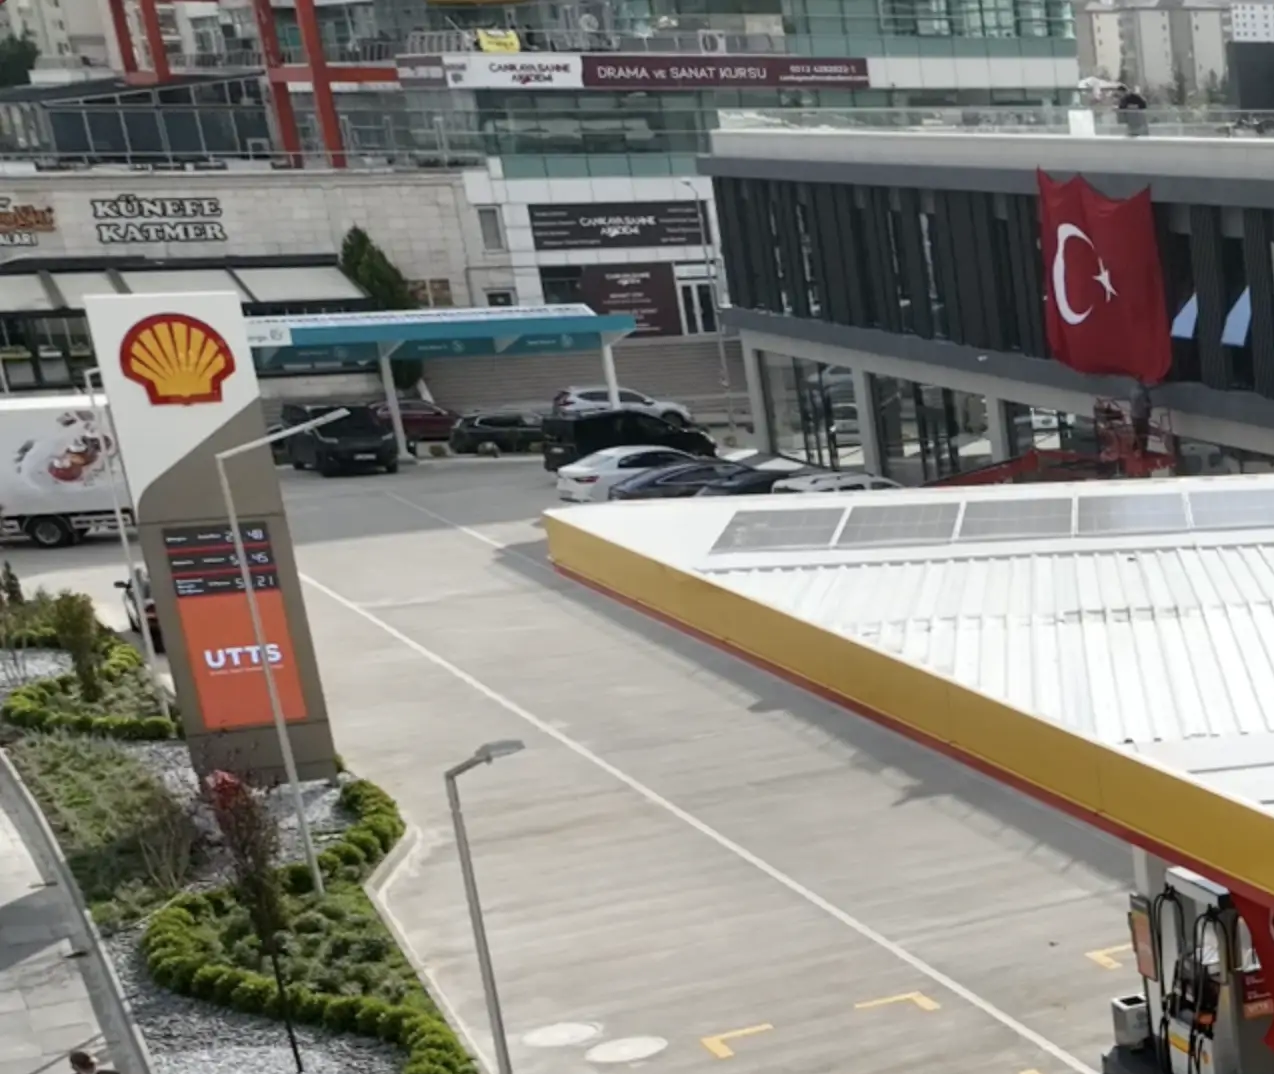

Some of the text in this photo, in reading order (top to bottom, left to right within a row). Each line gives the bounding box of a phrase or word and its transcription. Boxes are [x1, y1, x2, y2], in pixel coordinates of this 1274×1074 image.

[597, 66, 649, 79] DRAMA
[669, 67, 716, 79] SANAT
[719, 67, 767, 79] KURSU
[91, 194, 222, 219] KÜNEFE
[96, 222, 228, 243] KATMER
[204, 643, 283, 669] UTTS
